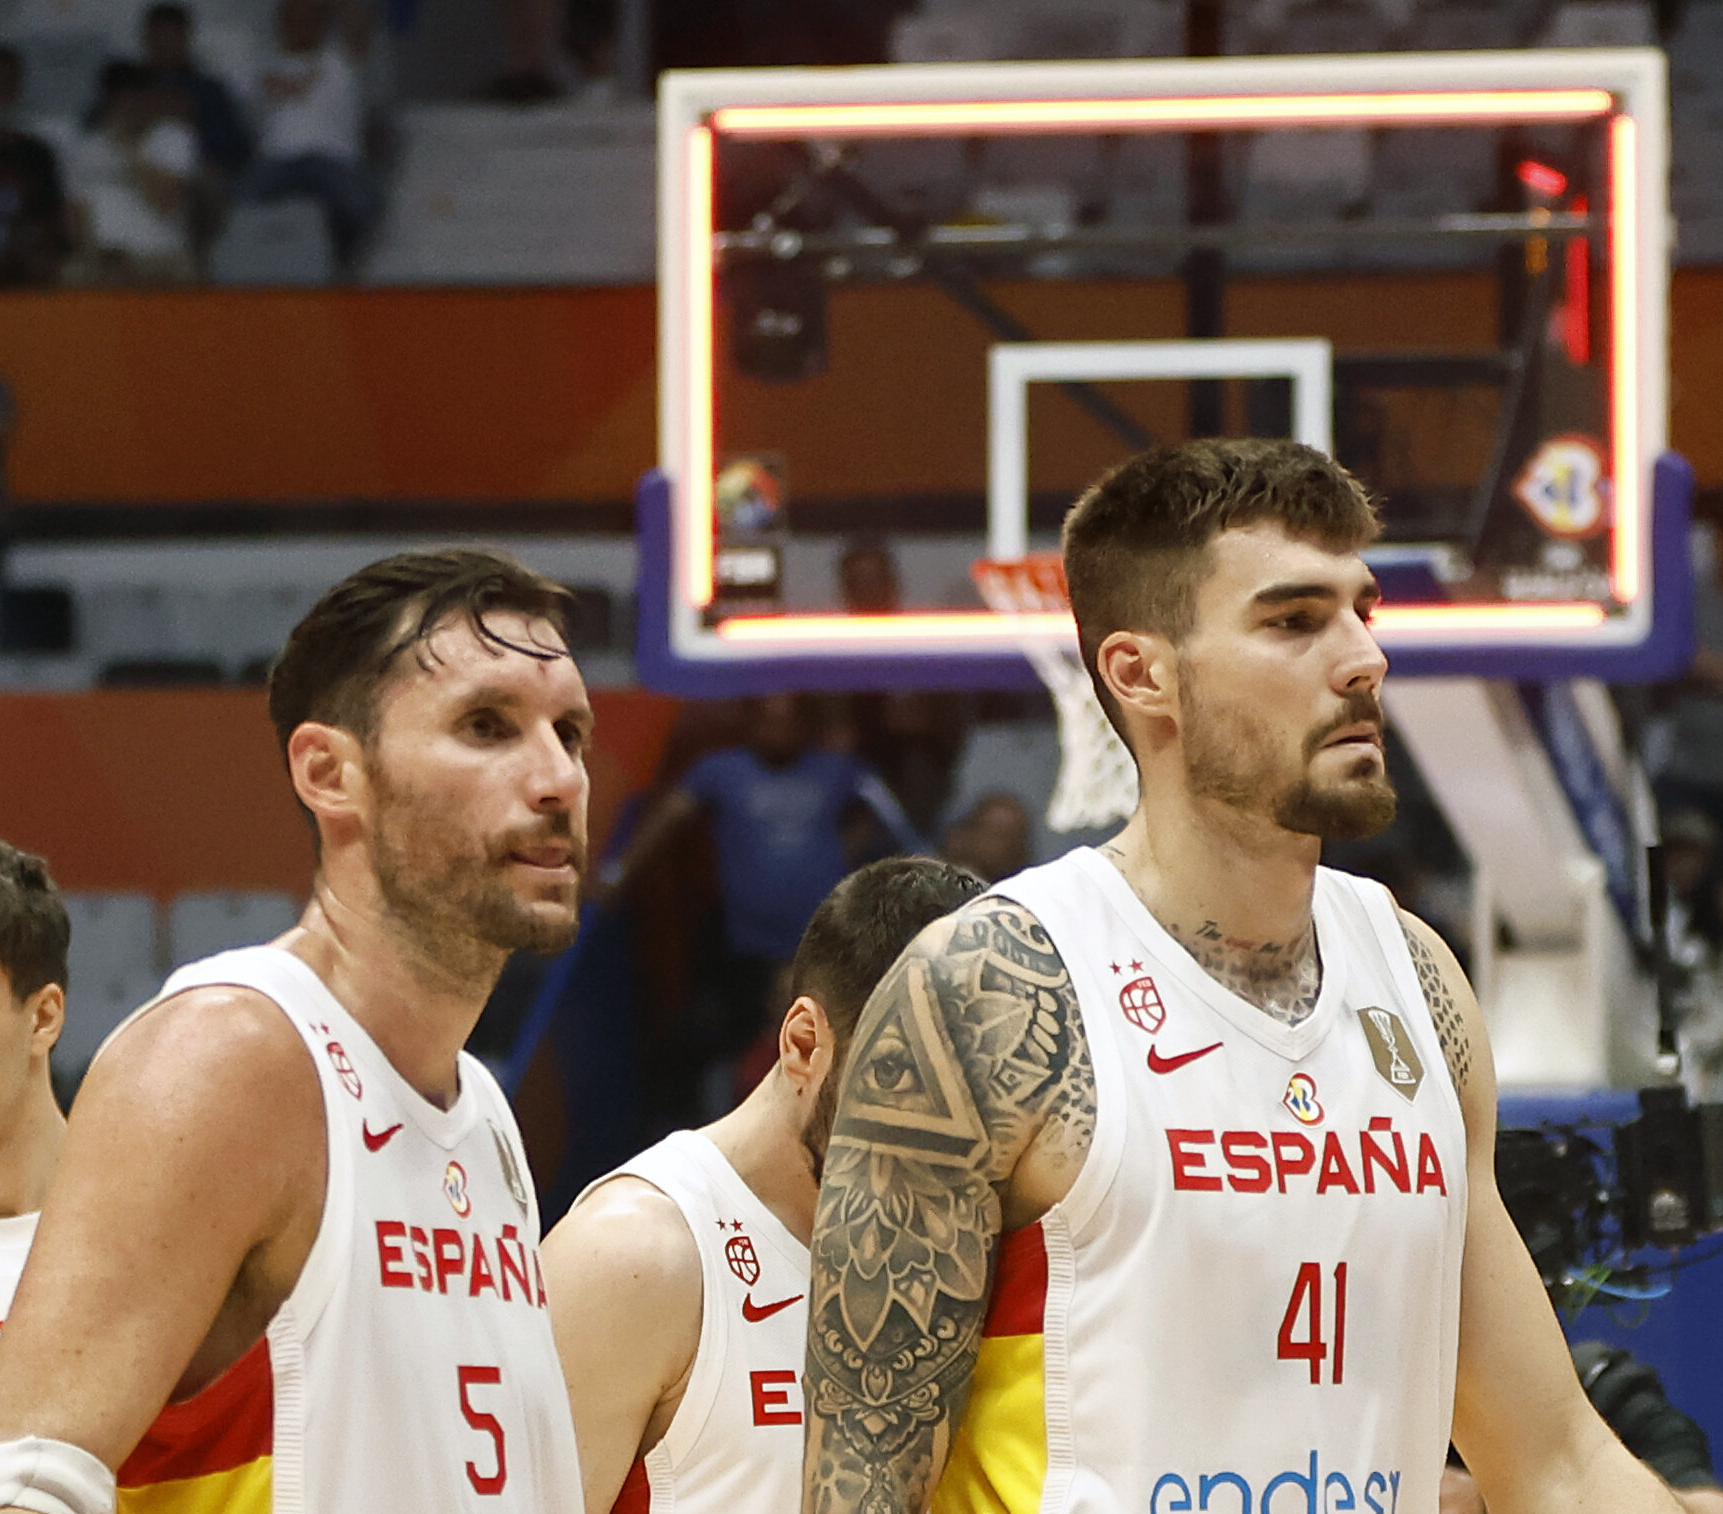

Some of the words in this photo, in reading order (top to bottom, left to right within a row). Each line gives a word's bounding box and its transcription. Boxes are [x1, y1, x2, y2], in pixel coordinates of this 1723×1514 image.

[1166, 1116, 1447, 1197] ESPAÑA
[1277, 1261, 1347, 1385] 41
[457, 1365, 506, 1495] 5
